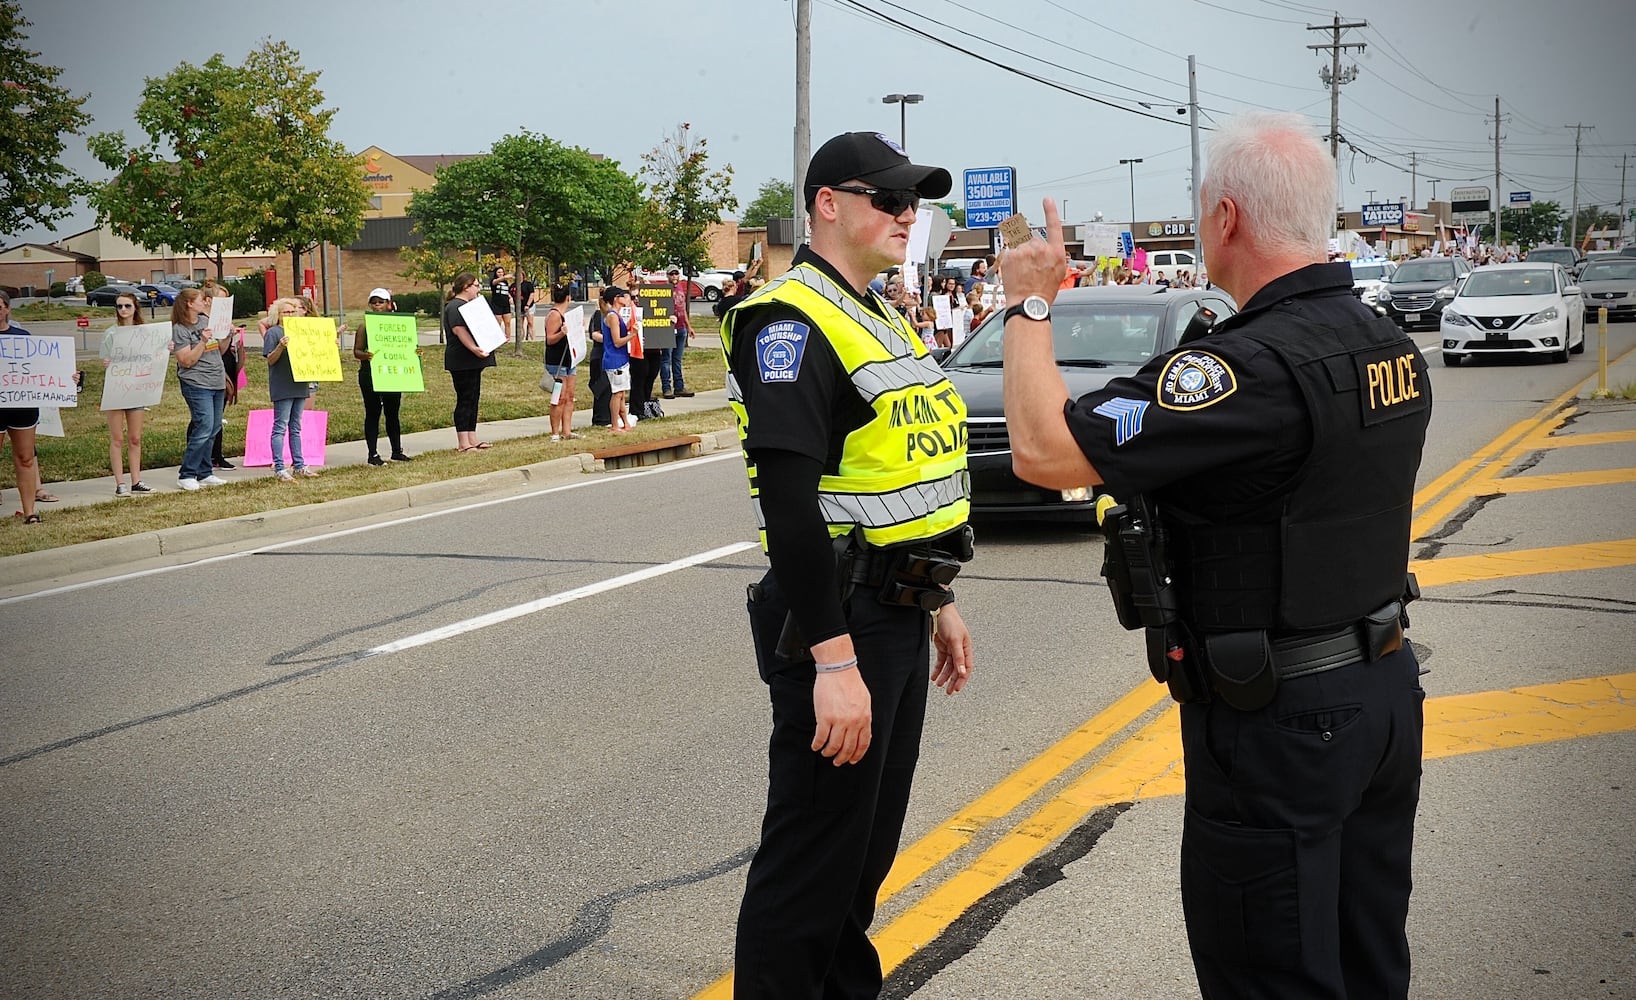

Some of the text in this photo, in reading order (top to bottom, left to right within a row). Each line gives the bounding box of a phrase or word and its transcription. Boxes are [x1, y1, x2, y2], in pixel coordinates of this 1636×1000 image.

[361, 173, 393, 182] omfort
[968, 172, 1009, 186] AVAILABLE
[968, 185, 993, 199] 3500
[982, 199, 1010, 207] INCLUDED
[975, 211, 1010, 222] 239-2616
[1363, 210, 1402, 221] TATTOO
[1007, 226, 1021, 238] THE
[1164, 223, 1186, 235] CBD
[640, 288, 671, 298] COERCION
[650, 299, 658, 308] IS
[653, 307, 667, 316] NOT
[379, 323, 407, 333] FORCED
[642, 318, 671, 327] CONSENT
[768, 323, 794, 334] MIAMI
[759, 331, 803, 346] TOWNSHIP
[0, 337, 60, 359] EEDOM
[8, 362, 31, 375] IS
[1201, 355, 1226, 376] POLICE
[764, 370, 794, 381] POLICE
[1181, 354, 1224, 394] DEPARTMENT
[0, 374, 67, 388] SENTIAL
[1367, 353, 1420, 410] POLICE
[1173, 391, 1210, 404] MIAMI
